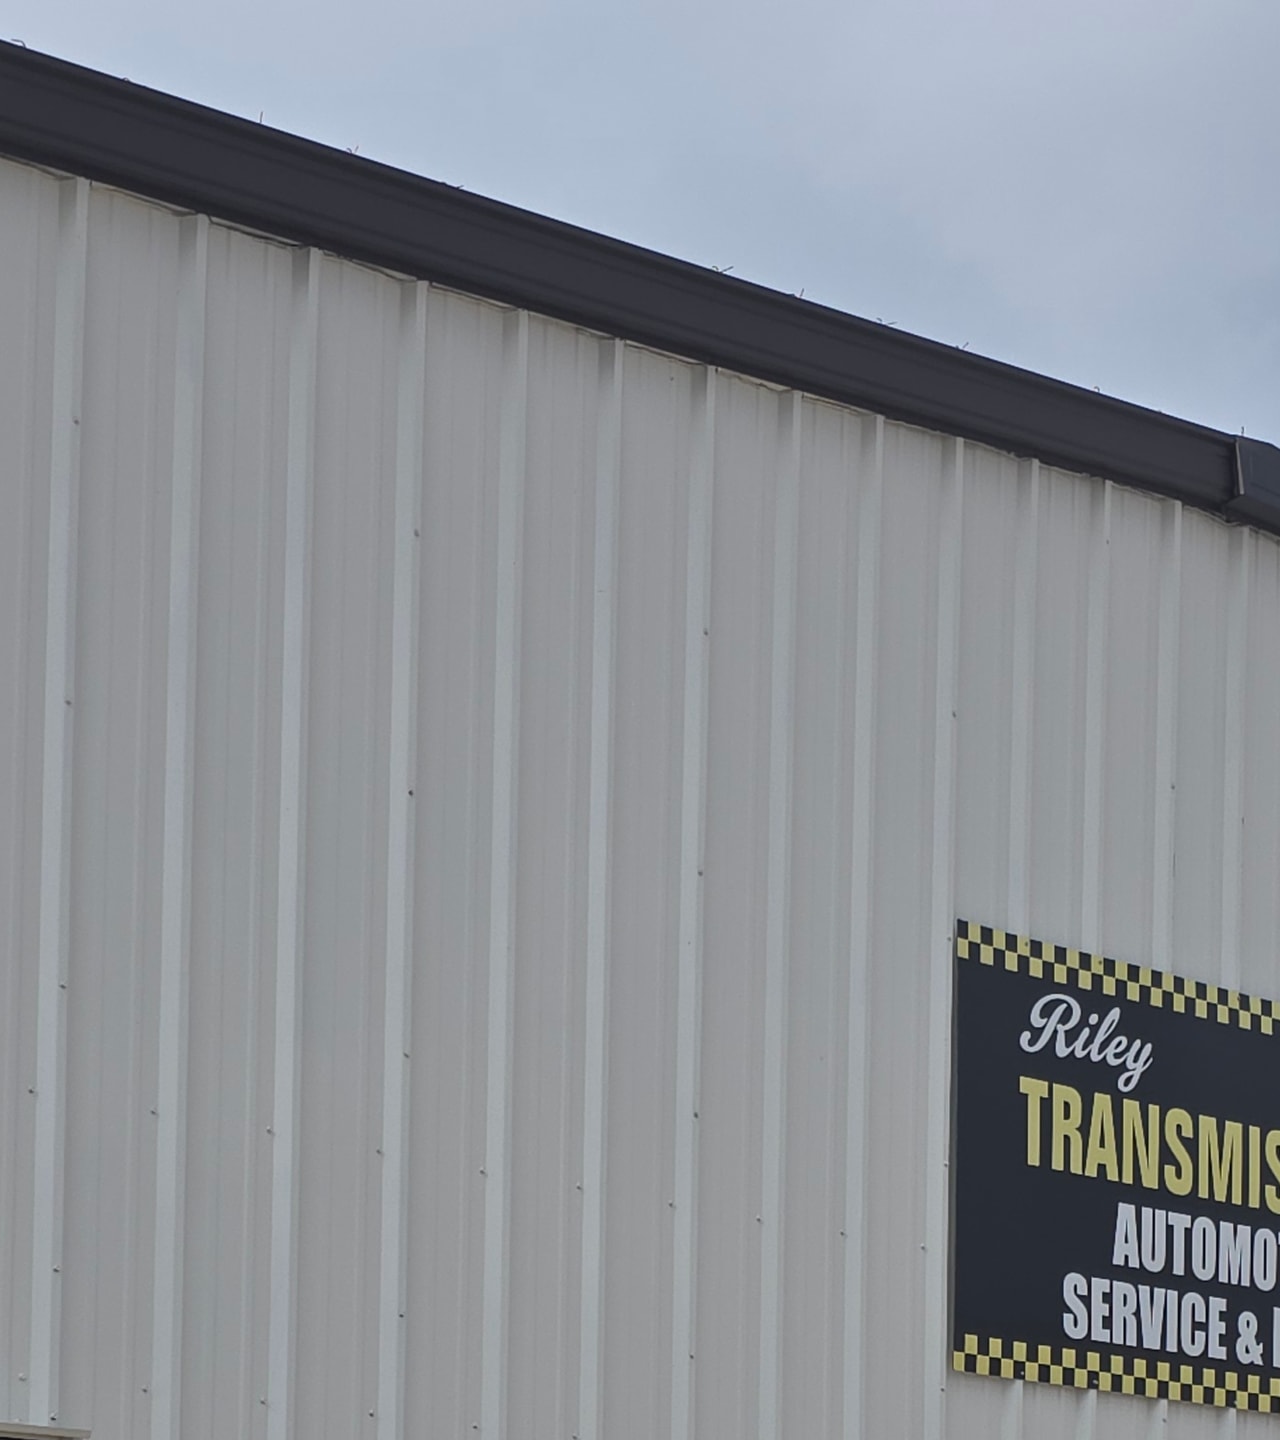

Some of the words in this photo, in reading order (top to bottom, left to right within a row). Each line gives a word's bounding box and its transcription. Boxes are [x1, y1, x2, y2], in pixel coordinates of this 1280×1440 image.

[1020, 994, 1153, 1092] Riley
[1063, 1273, 1227, 1360] SERVICE
[1236, 1311, 1263, 1365] &
